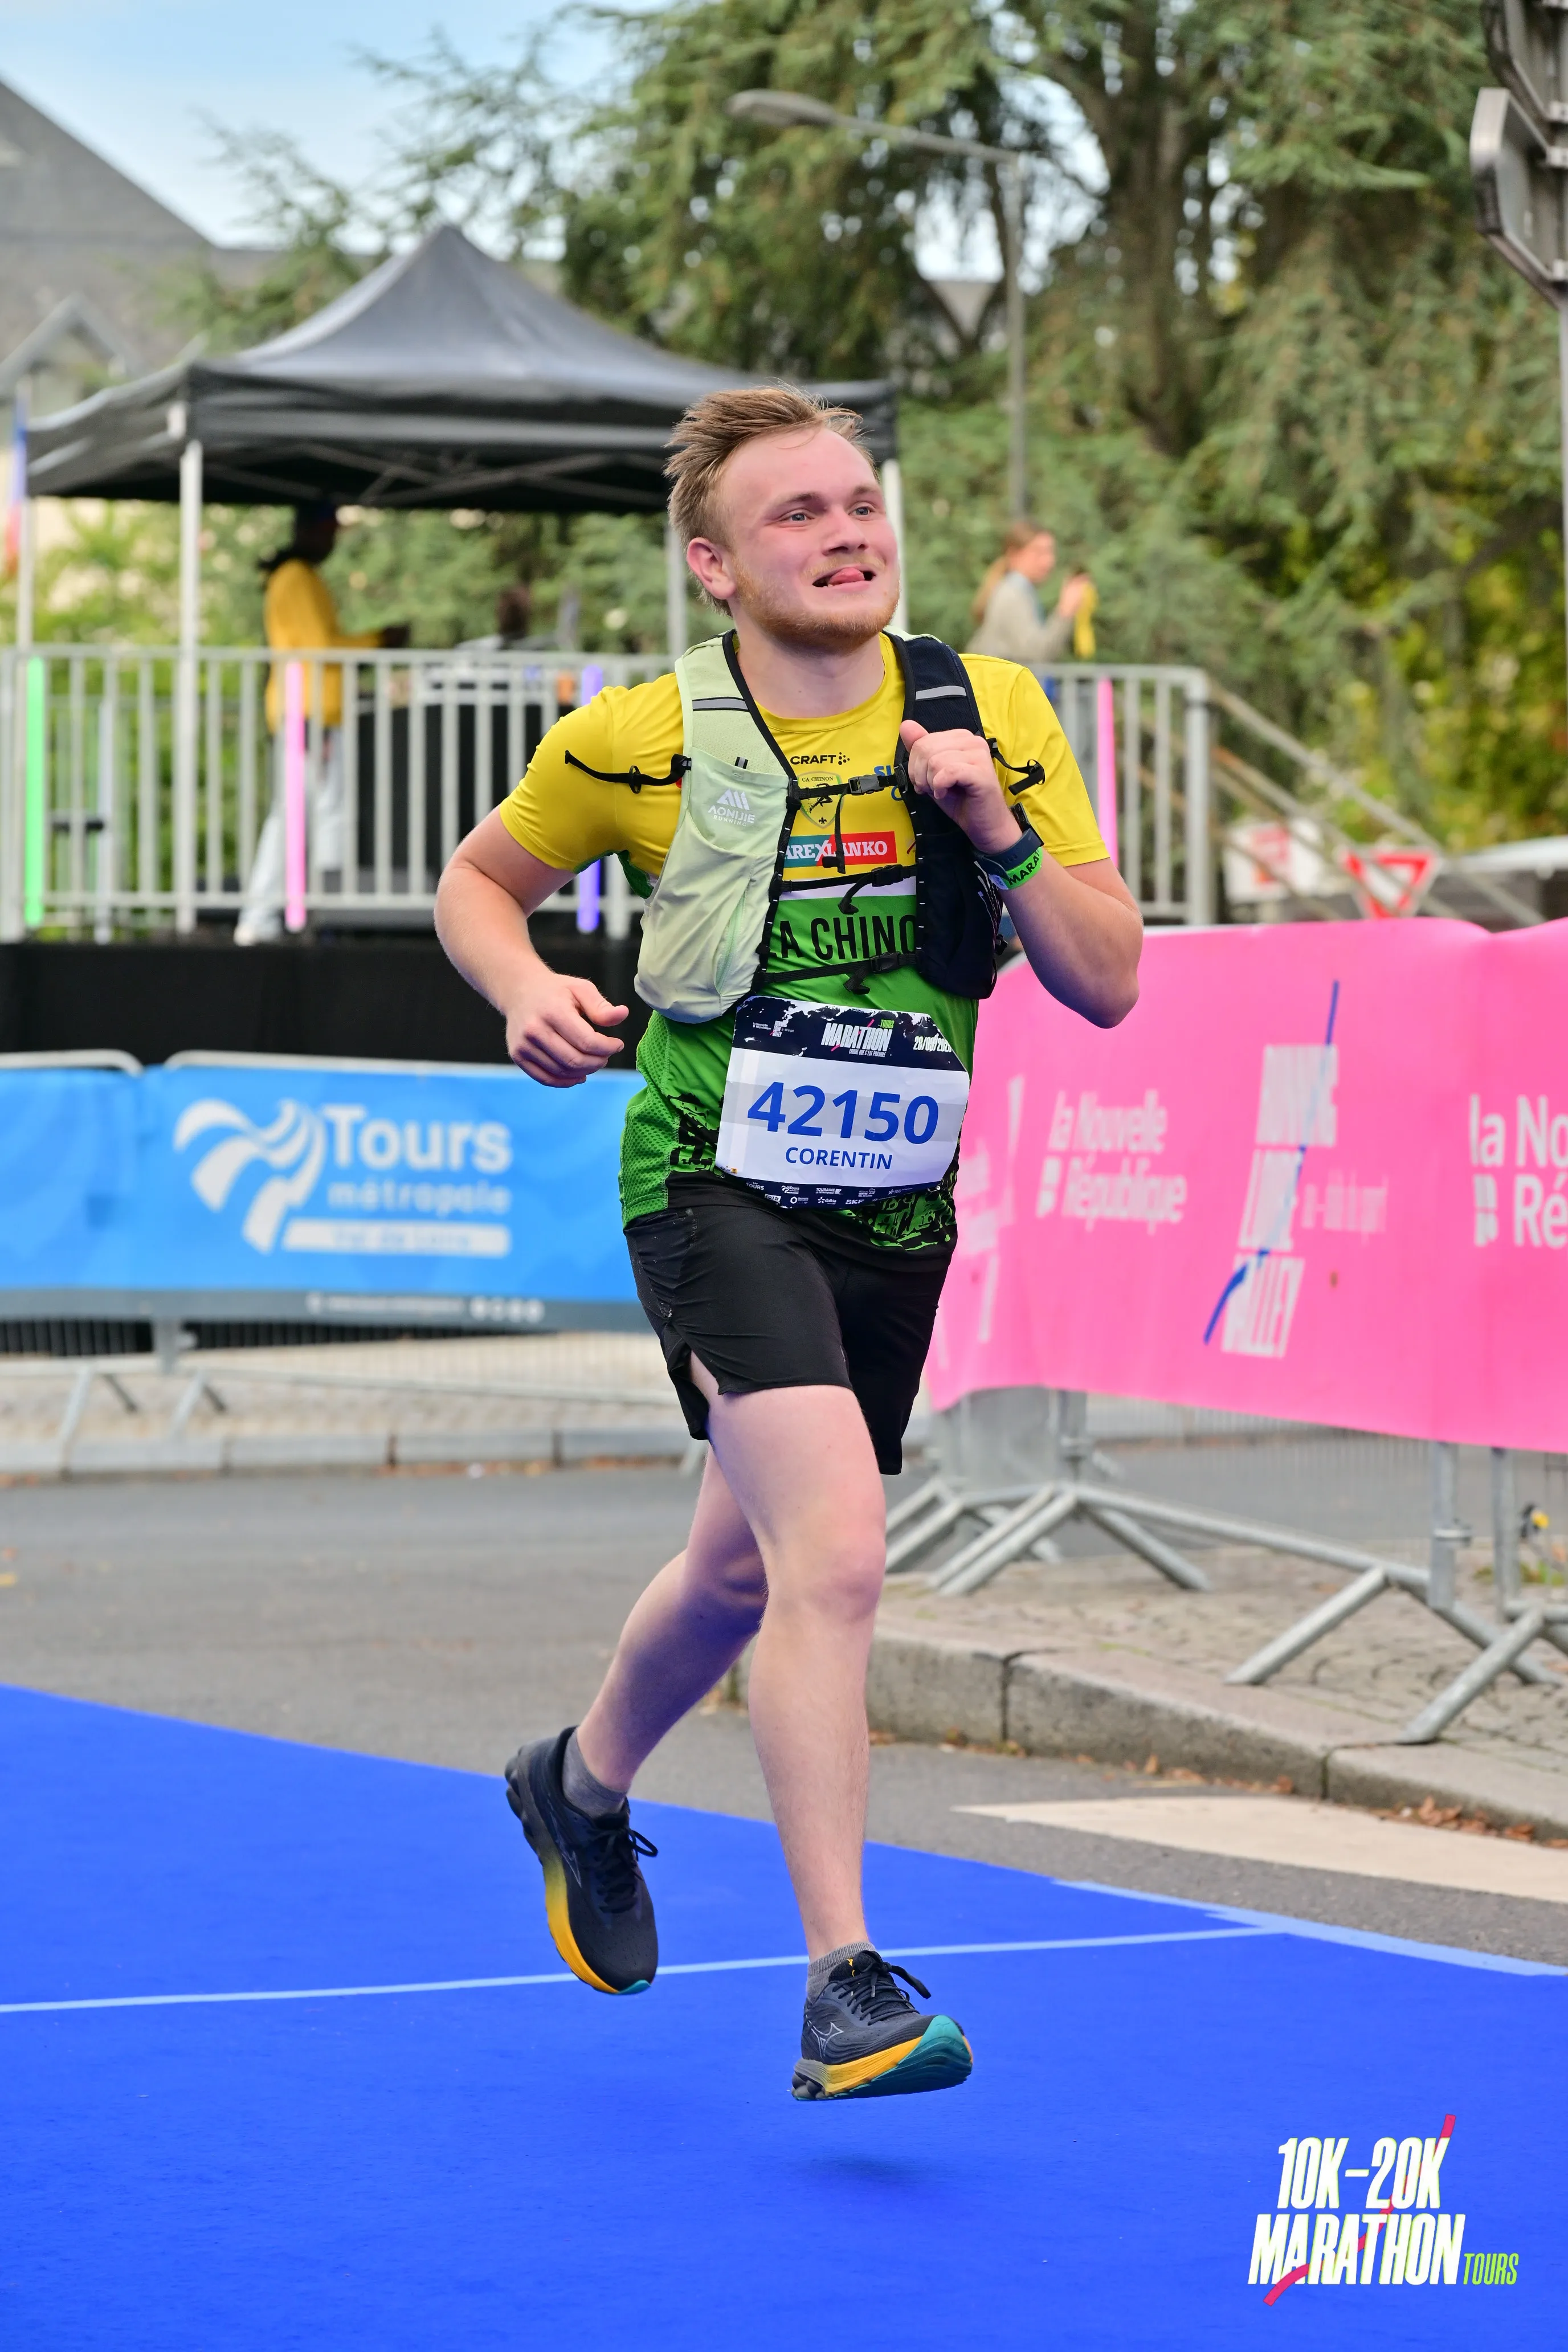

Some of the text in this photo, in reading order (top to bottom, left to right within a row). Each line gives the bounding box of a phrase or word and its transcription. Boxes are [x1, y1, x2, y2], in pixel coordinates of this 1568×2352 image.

[790, 754, 836, 765] CRAFT
[708, 805, 756, 824] AONIJIE
[713, 815, 747, 827] RUNNING
[1008, 851, 1040, 885] MARA
[810, 914, 916, 960] CHINO
[820, 1022, 893, 1052] MARATHON
[880, 1019, 895, 1028] TOURS
[747, 1081, 940, 1145] 42150
[322, 1104, 512, 1174] Tours
[1469, 1093, 1506, 1166] la
[785, 1146, 893, 1170] CORENTIN
